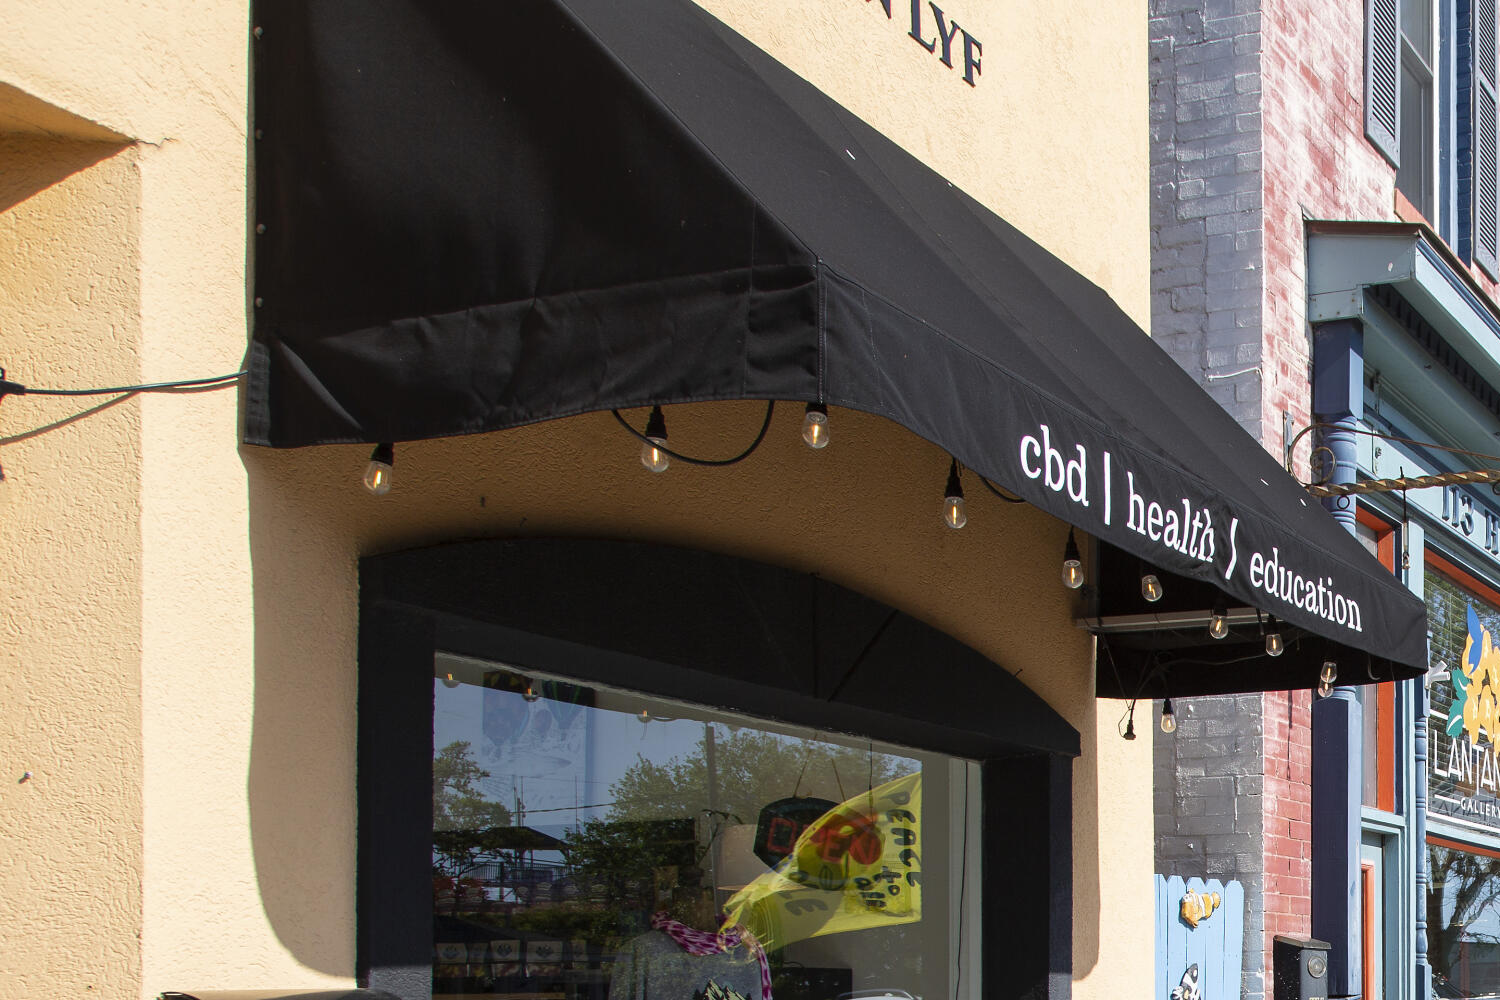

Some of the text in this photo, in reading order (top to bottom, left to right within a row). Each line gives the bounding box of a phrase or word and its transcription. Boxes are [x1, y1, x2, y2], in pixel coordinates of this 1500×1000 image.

[1020, 424, 1089, 507] cbd
[1127, 471, 1215, 563] health
[1250, 547, 1362, 633] education
[1441, 485, 1474, 537] 113
